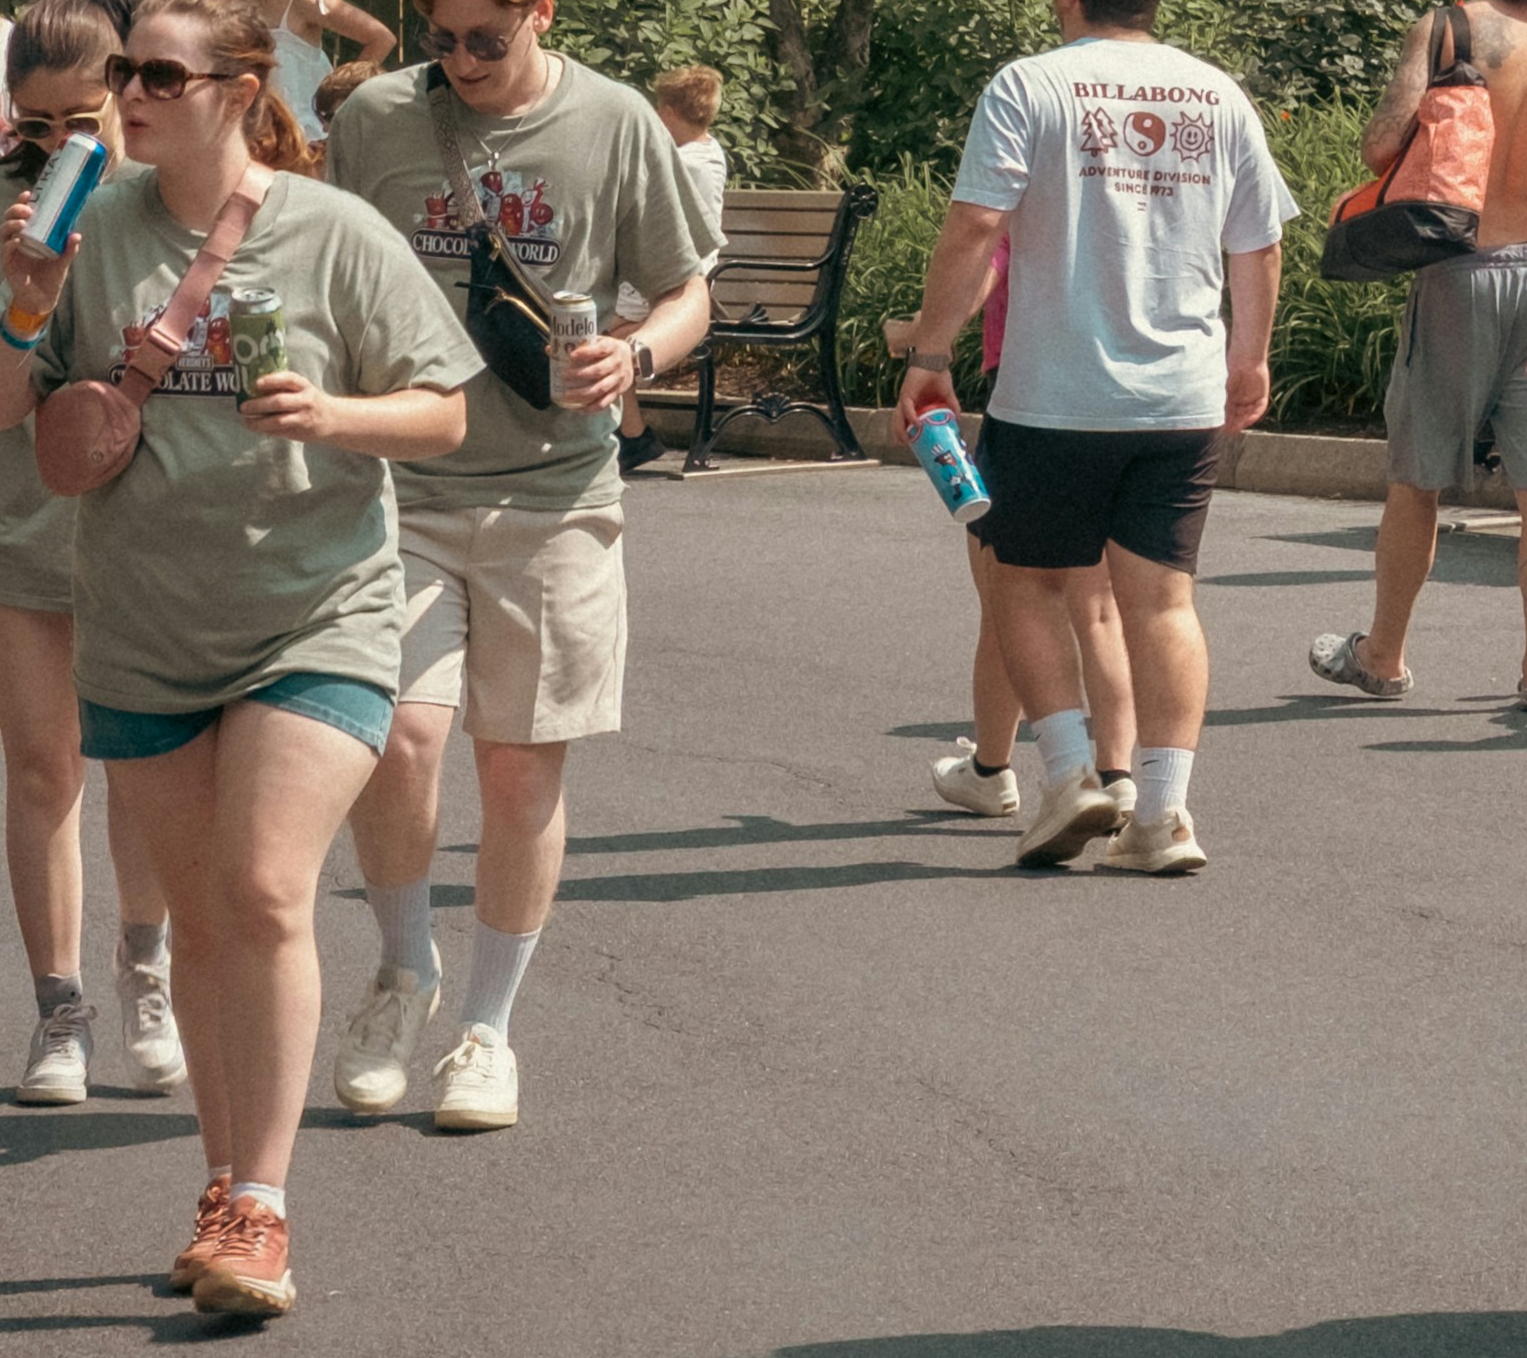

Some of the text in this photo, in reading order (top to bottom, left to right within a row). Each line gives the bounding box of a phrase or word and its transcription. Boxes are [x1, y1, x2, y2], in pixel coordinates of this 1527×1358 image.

[1073, 82, 1220, 105] BILLABONG
[1079, 166, 1211, 185] ADVENTURE DIVISION
[1114, 182, 1173, 197] SINCE 1973
[412, 234, 472, 255] CHOCOL
[111, 368, 212, 392] COLATE
